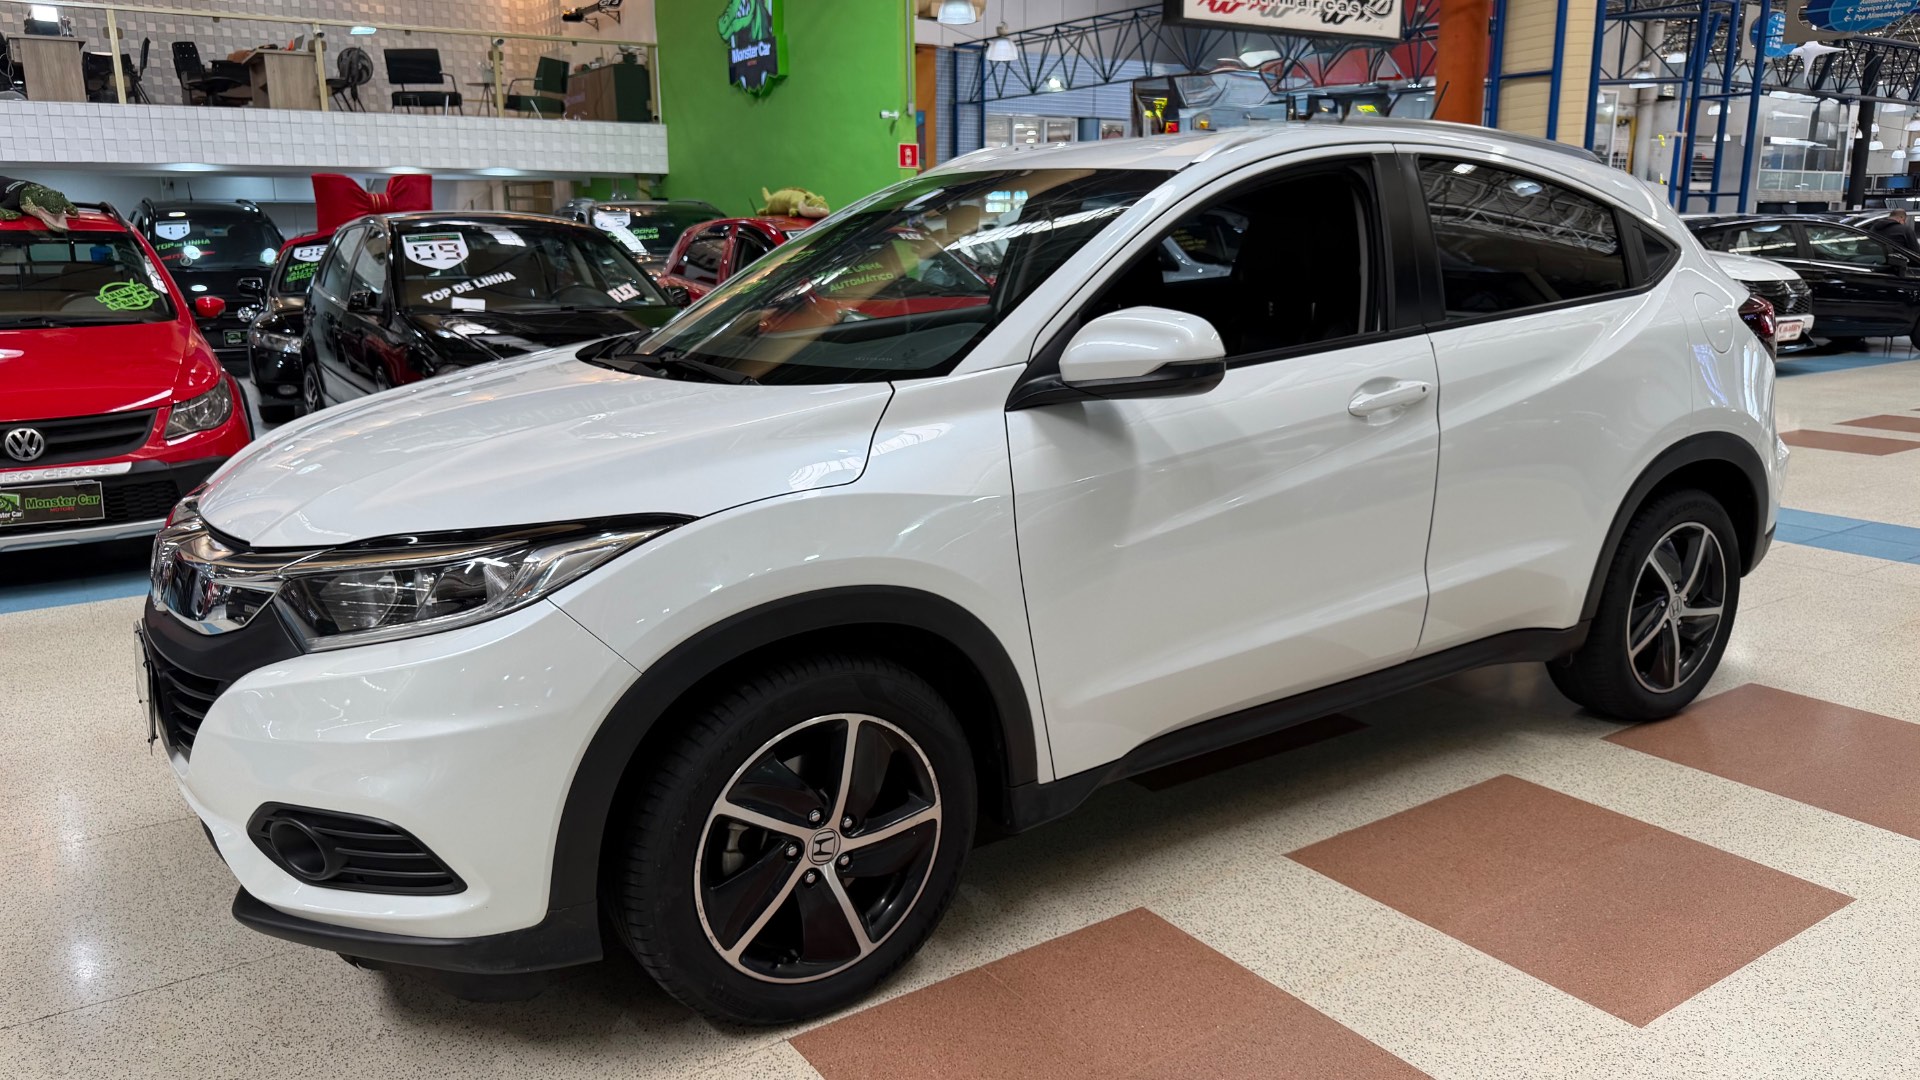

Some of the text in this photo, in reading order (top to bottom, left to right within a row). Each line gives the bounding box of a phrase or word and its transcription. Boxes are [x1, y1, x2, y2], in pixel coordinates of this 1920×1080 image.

[1893, 1, 1912, 9] Apoio
[1867, 10, 1905, 19] Alimentação
[731, 41, 771, 64] Monster Car
[156, 242, 175, 251] TOP
[183, 238, 212, 247] LINHA
[412, 243, 462, 261] 09
[288, 262, 311, 272] TOP
[852, 261, 883, 273] LINHA
[422, 271, 517, 304] TOP DE LINHA
[829, 272, 895, 293] AUTOMÁTICO
[607, 282, 640, 304] FLEX
[25, 494, 100, 509] Monster Car
